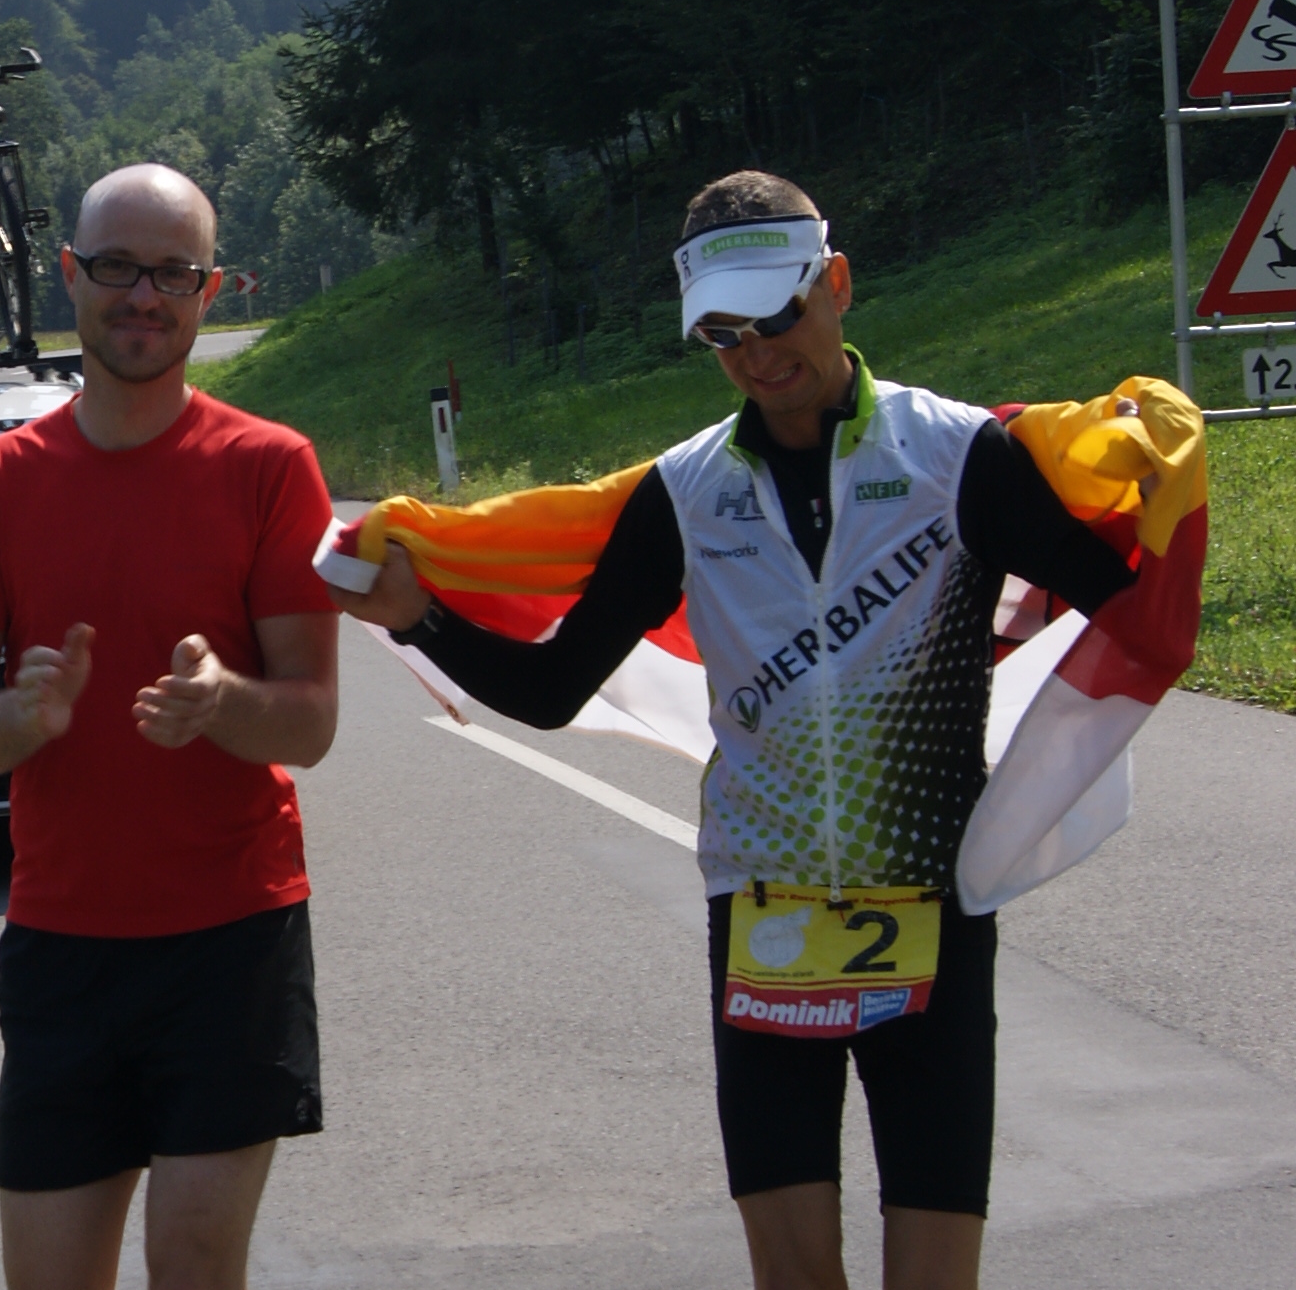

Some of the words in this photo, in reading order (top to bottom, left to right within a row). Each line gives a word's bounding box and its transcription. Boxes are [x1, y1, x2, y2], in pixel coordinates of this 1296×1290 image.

[715, 232, 788, 251] HERBALIFE
[753, 516, 954, 706] HERBALIFE
[840, 909, 900, 973] 2
[727, 992, 856, 1026] Dominik
